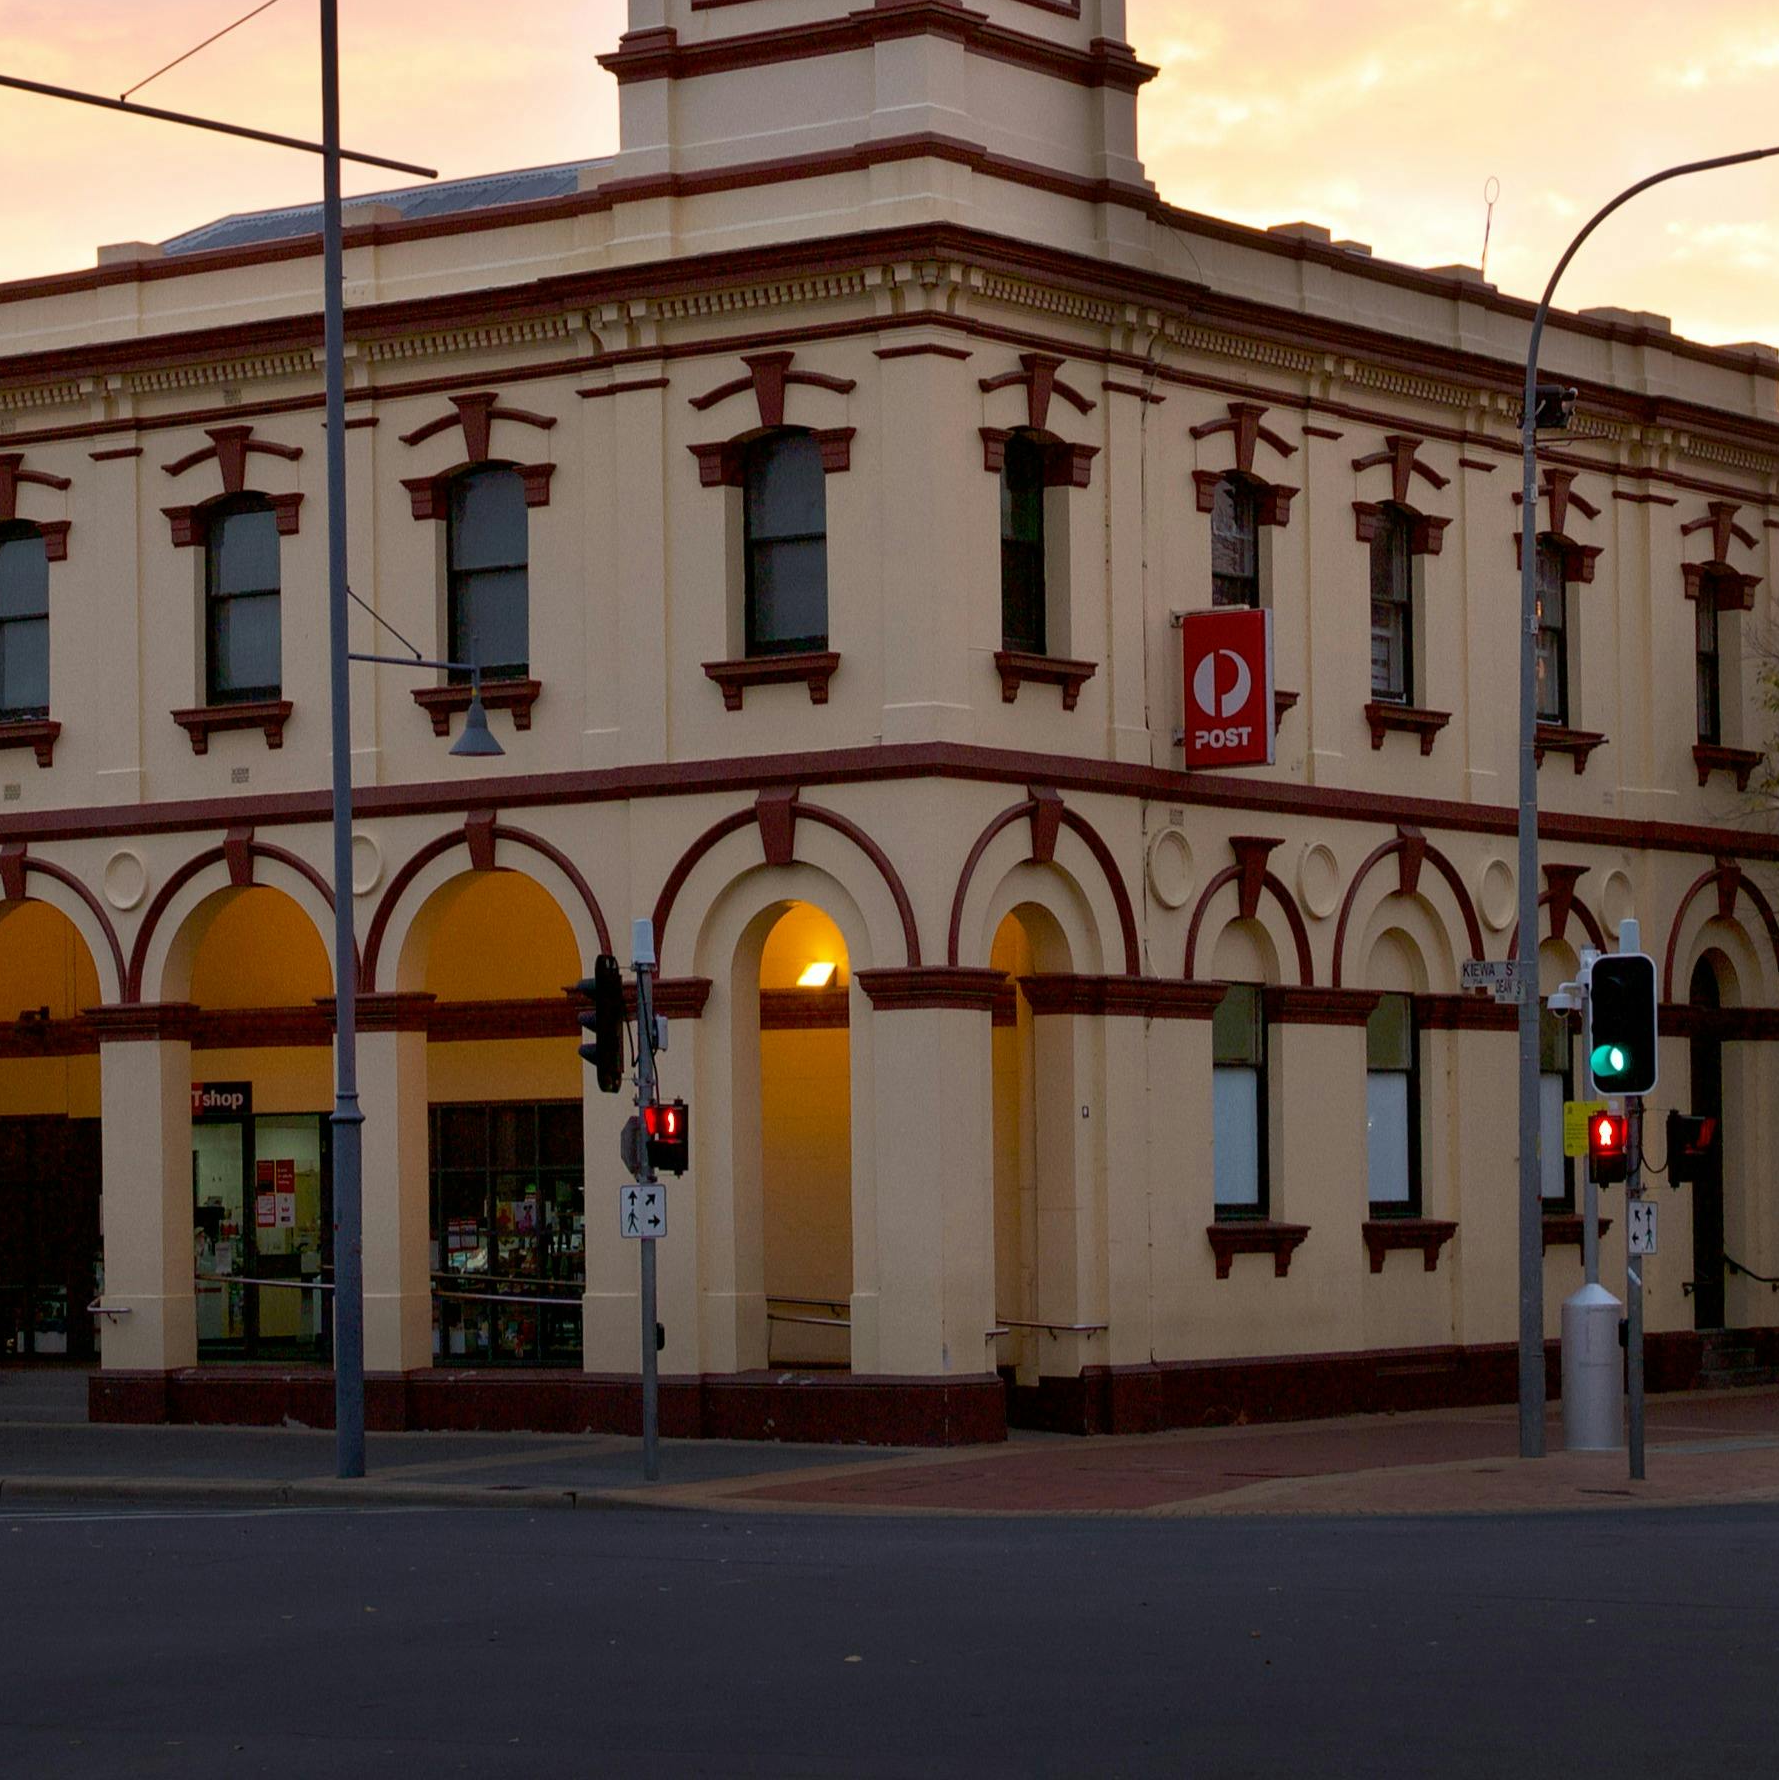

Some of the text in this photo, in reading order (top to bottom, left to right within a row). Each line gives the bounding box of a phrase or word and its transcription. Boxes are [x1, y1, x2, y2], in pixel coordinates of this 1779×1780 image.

[1195, 726, 1253, 750] POST
[1462, 963, 1496, 978] KIEWA
[191, 1090, 244, 1110] Tshop
